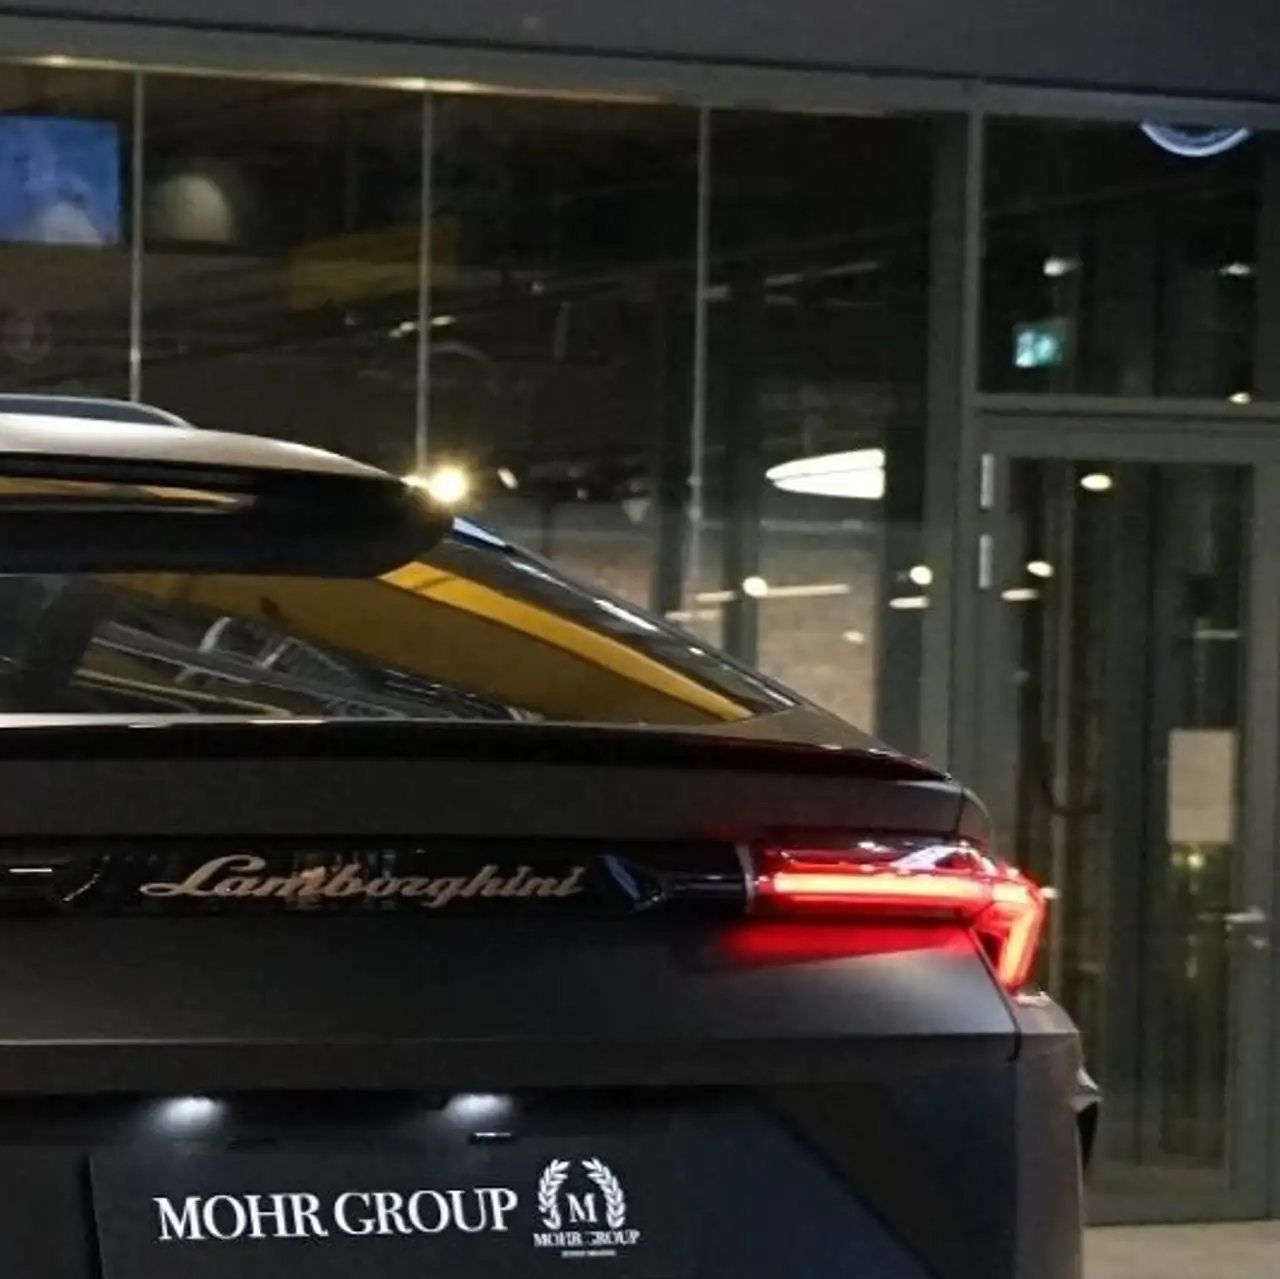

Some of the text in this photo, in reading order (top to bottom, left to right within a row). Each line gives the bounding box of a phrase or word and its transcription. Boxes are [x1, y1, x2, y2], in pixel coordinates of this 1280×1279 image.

[140, 854, 585, 908] Lamborghini
[153, 1187, 519, 1241] MOHR GROUP
[565, 1192, 598, 1223] M
[532, 1230, 582, 1247] MOHR
